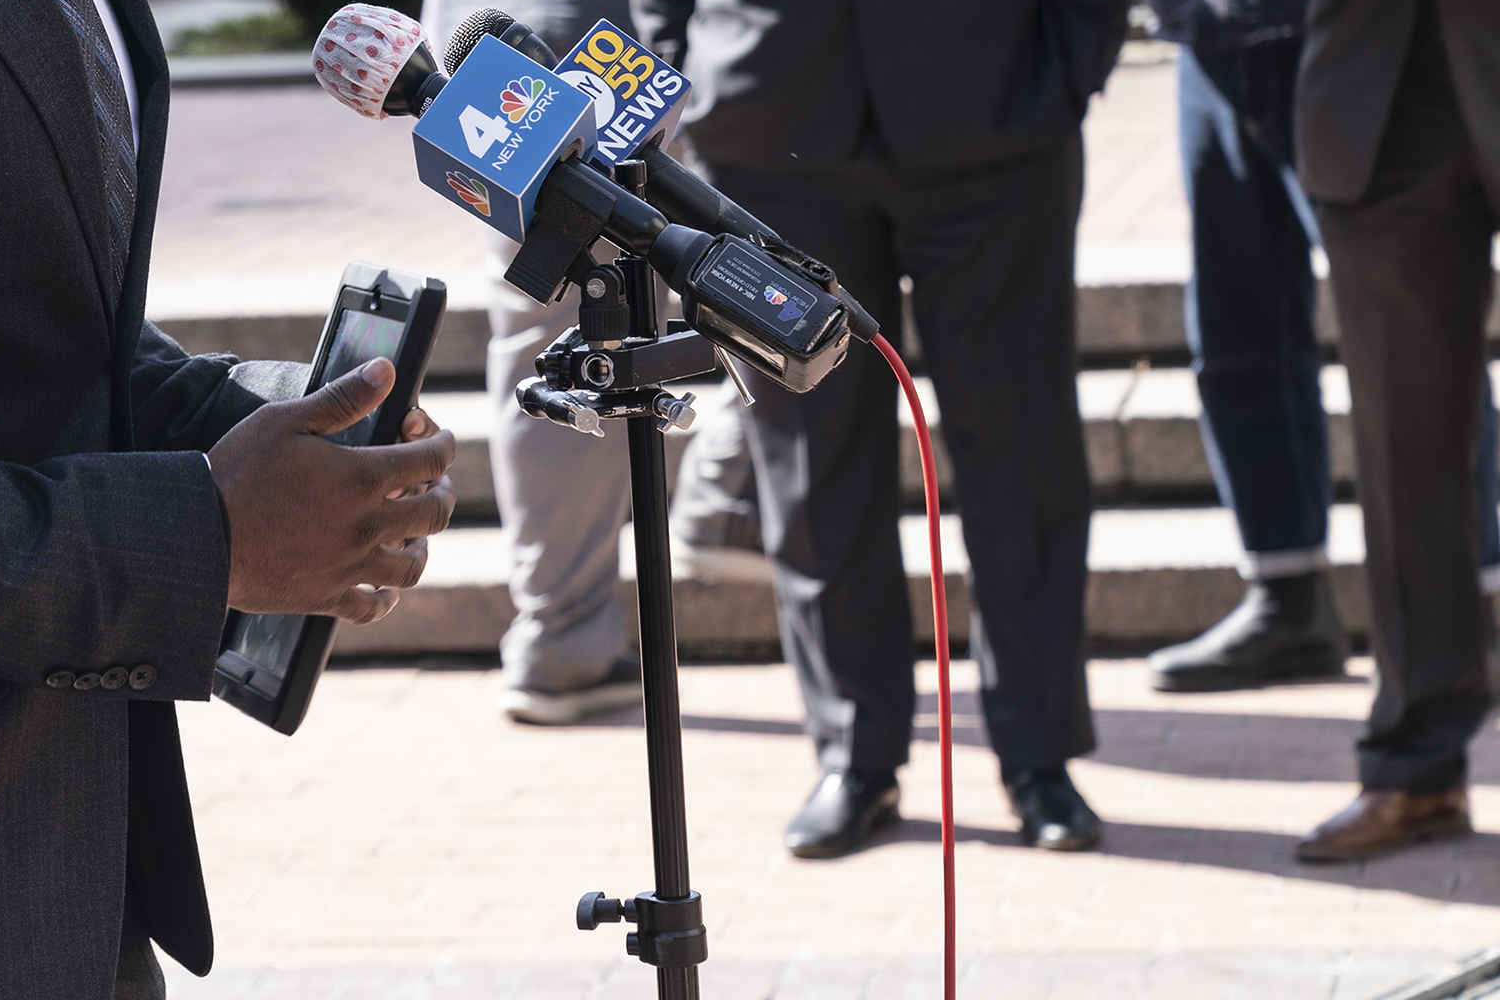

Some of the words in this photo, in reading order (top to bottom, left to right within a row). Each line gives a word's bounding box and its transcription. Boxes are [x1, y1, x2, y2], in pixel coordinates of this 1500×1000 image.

[573, 30, 624, 76] 10
[603, 46, 655, 100] 55
[598, 69, 683, 161] NEWS
[458, 104, 513, 159] 4
[491, 132, 524, 171] NEW
[519, 87, 560, 130] YORK
[711, 268, 726, 281] YORK
[724, 278, 740, 290] NEW
[742, 289, 756, 300] NBC
[770, 280, 792, 297] YORK
[777, 300, 804, 322] 4
[790, 294, 810, 309] NEW
